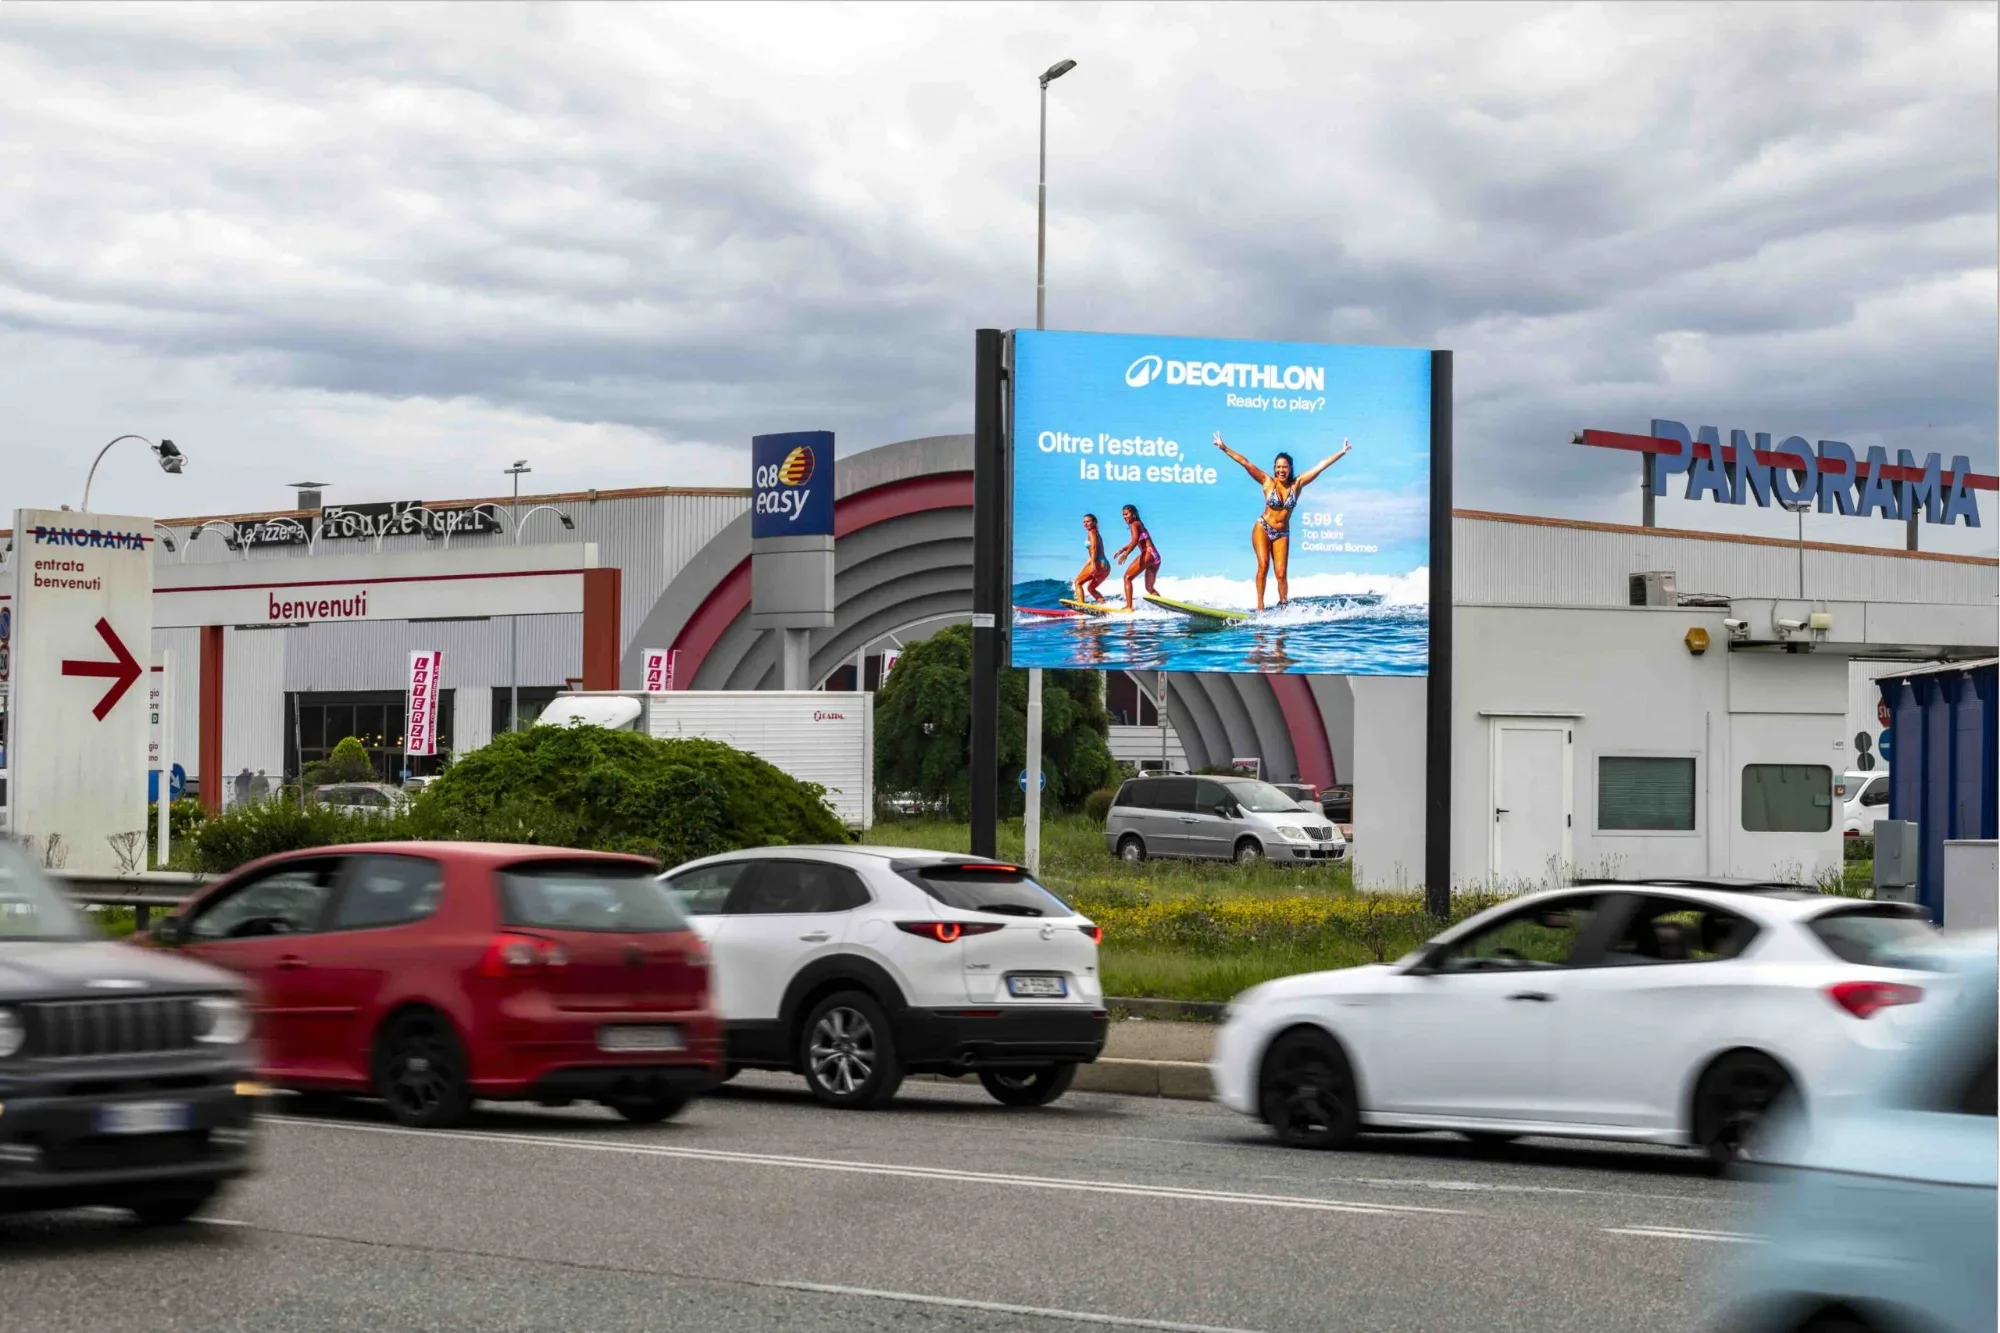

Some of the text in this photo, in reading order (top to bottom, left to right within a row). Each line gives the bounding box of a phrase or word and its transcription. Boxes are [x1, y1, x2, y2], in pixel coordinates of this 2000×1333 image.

[1166, 360, 1325, 390] DECATHLON
[1227, 393, 1326, 412] Ready to play?
[1038, 431, 1185, 462] Oltre l'estate,
[756, 464, 778, 488] Q8
[1080, 458, 1218, 484] la tua estate
[1650, 418, 1981, 528] PANORAMA
[756, 489, 810, 521] easy
[1334, 512, 1344, 526] €
[35, 526, 145, 551] PANORAMA
[1301, 529, 1319, 540] Top
[1301, 541, 1378, 552] Costume Borneo
[35, 559, 84, 572] entrata
[34, 572, 101, 590] benvenuti
[269, 590, 367, 620] benvenuti
[411, 658, 427, 749] LATERZA
